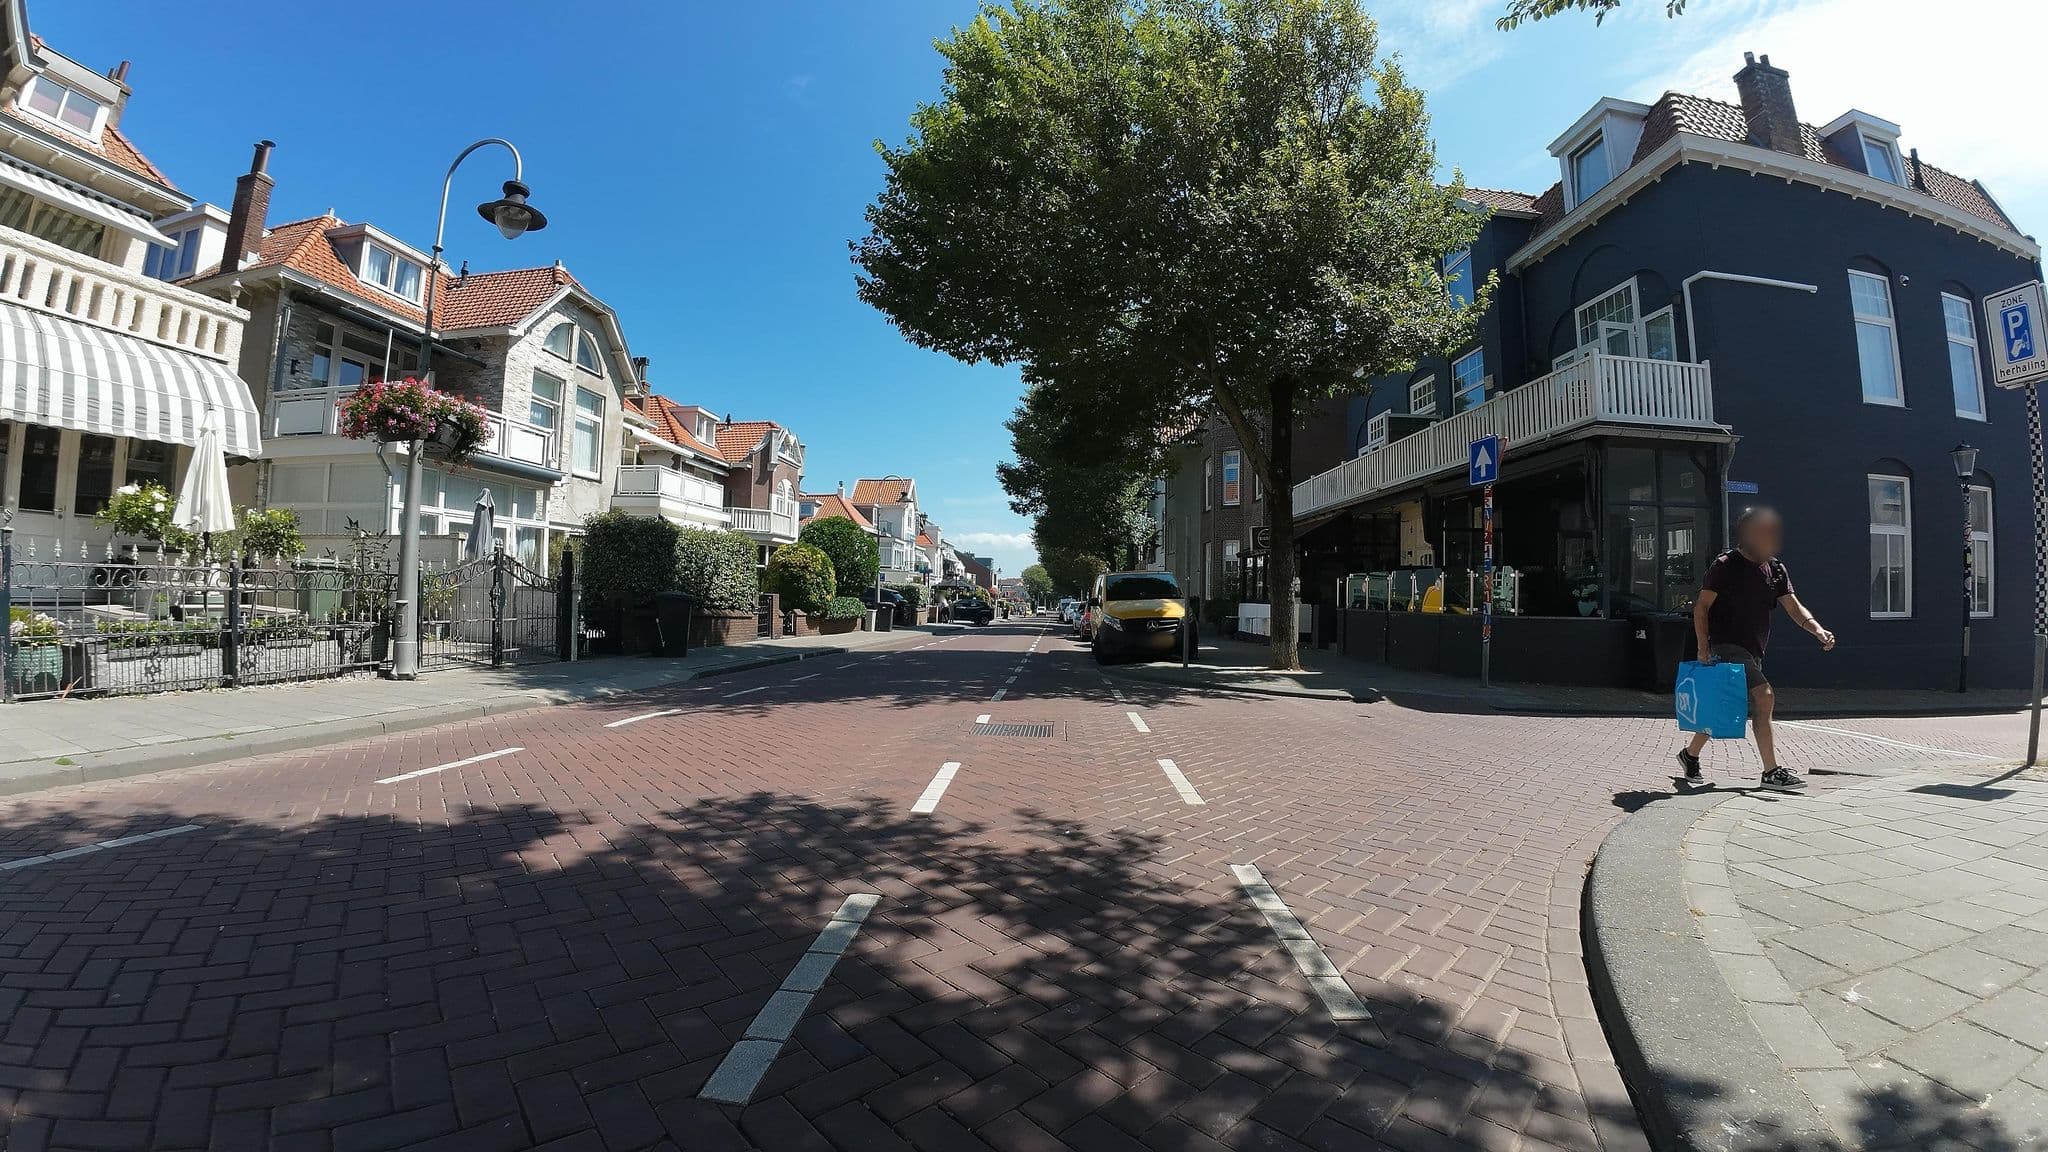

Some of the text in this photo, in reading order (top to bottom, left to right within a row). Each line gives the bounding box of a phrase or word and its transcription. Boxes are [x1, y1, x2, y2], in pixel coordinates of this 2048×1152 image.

[2000, 294, 2023, 308] ZONE
[2007, 310, 2024, 339] P
[2000, 360, 2046, 377] herhaling
